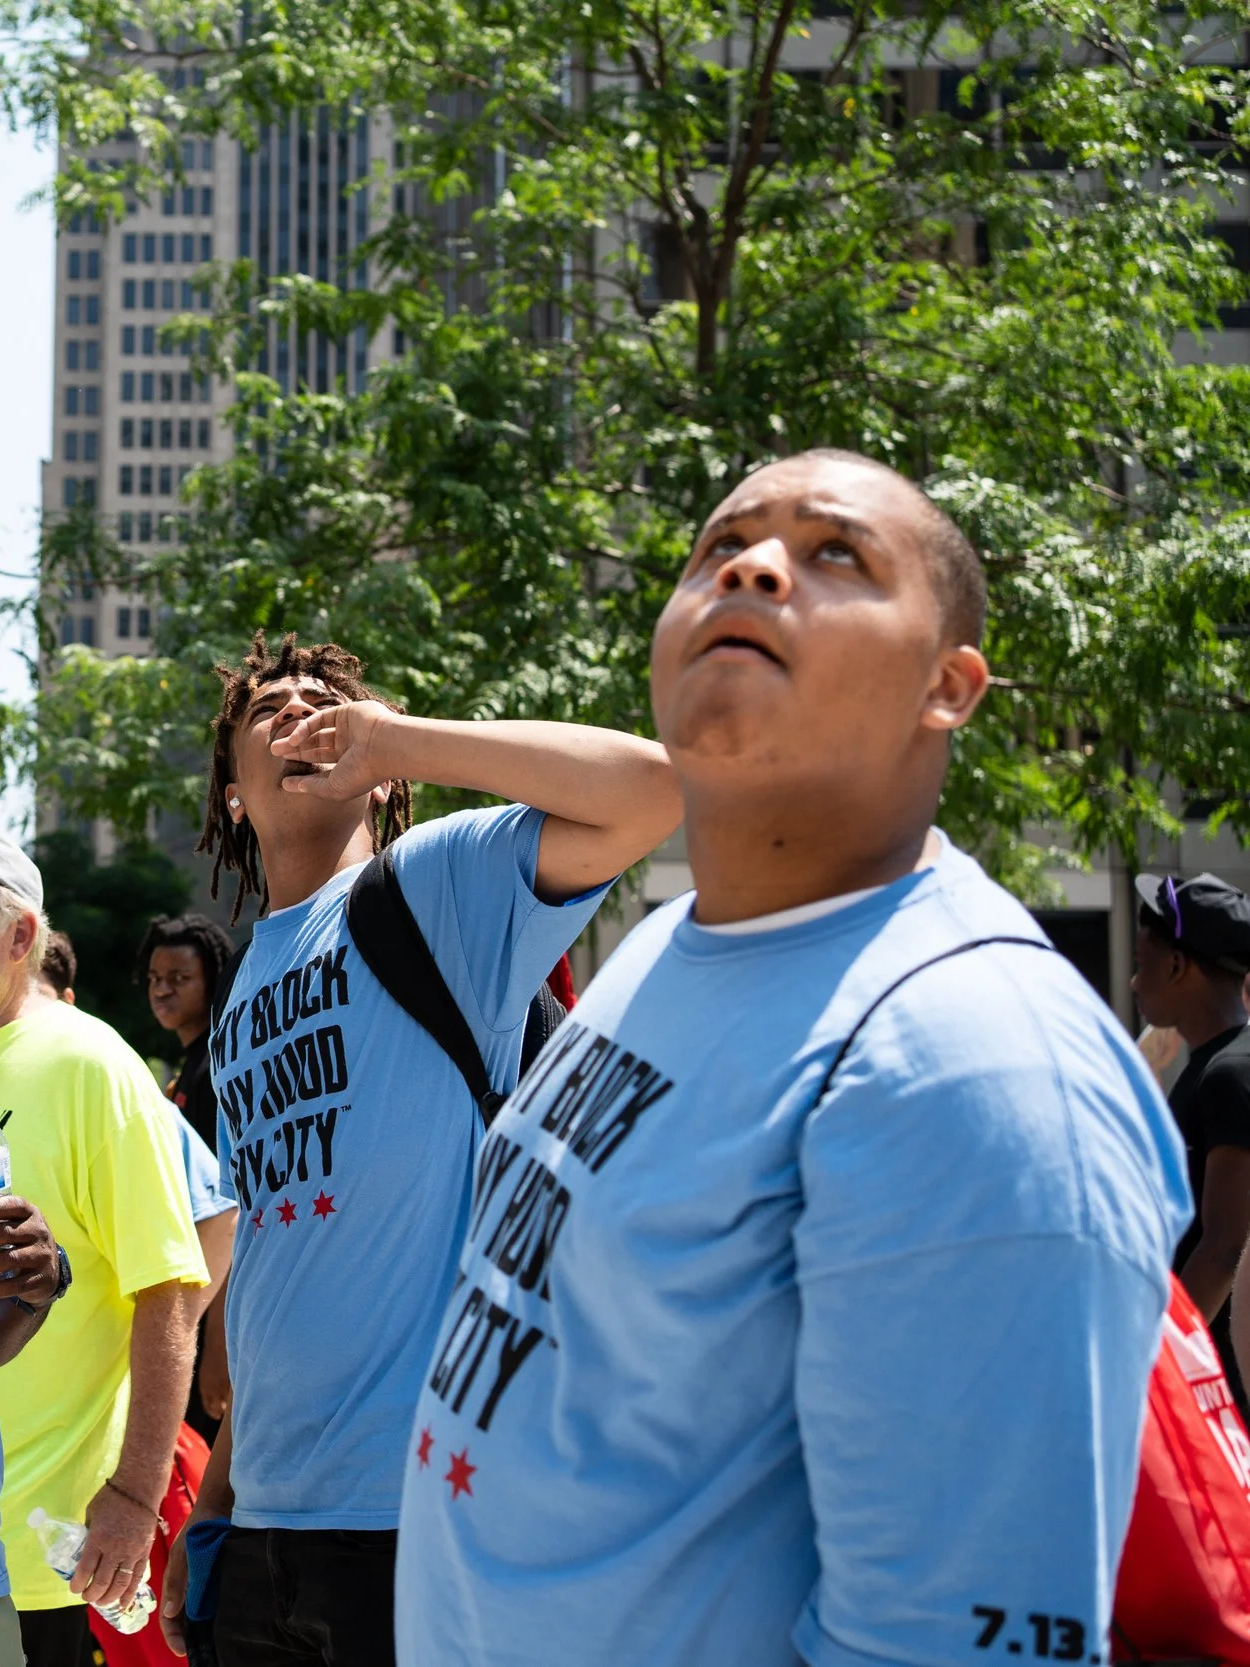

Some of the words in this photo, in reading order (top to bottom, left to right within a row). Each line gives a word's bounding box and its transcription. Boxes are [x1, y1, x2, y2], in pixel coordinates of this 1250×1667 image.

[211, 1000, 247, 1076] MY
[251, 945, 349, 1049] BLOCK
[261, 1024, 348, 1120] HOOD
